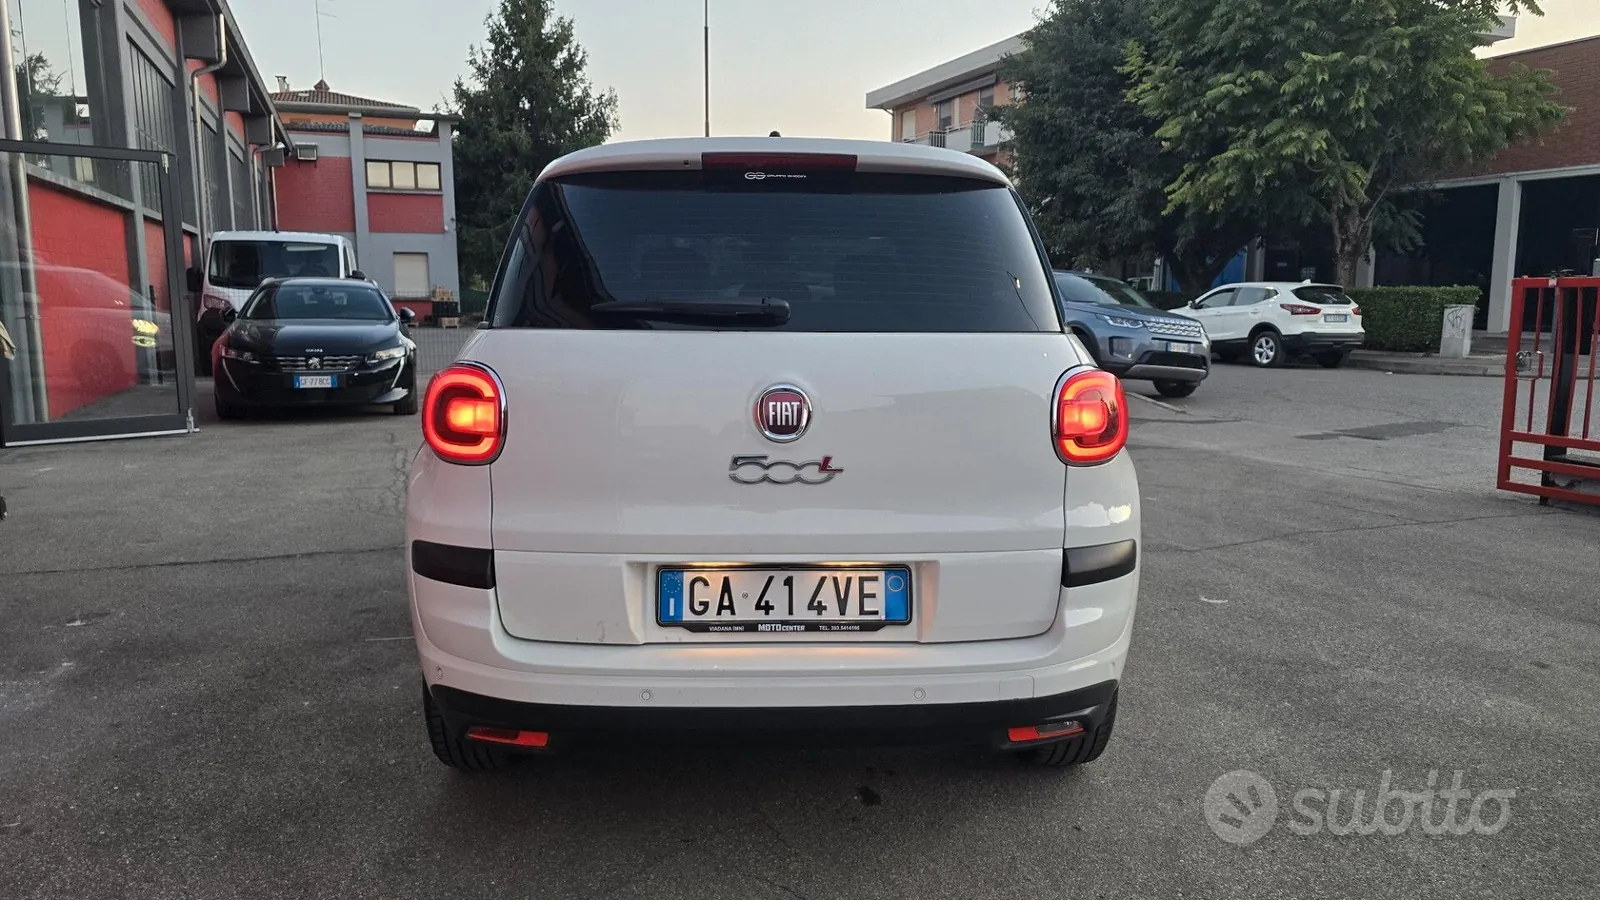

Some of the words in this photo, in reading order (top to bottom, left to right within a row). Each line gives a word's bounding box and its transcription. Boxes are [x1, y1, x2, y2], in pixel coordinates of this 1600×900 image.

[768, 401, 800, 426] FIAT
[689, 575, 736, 616] GA
[754, 575, 879, 616] 414VE
